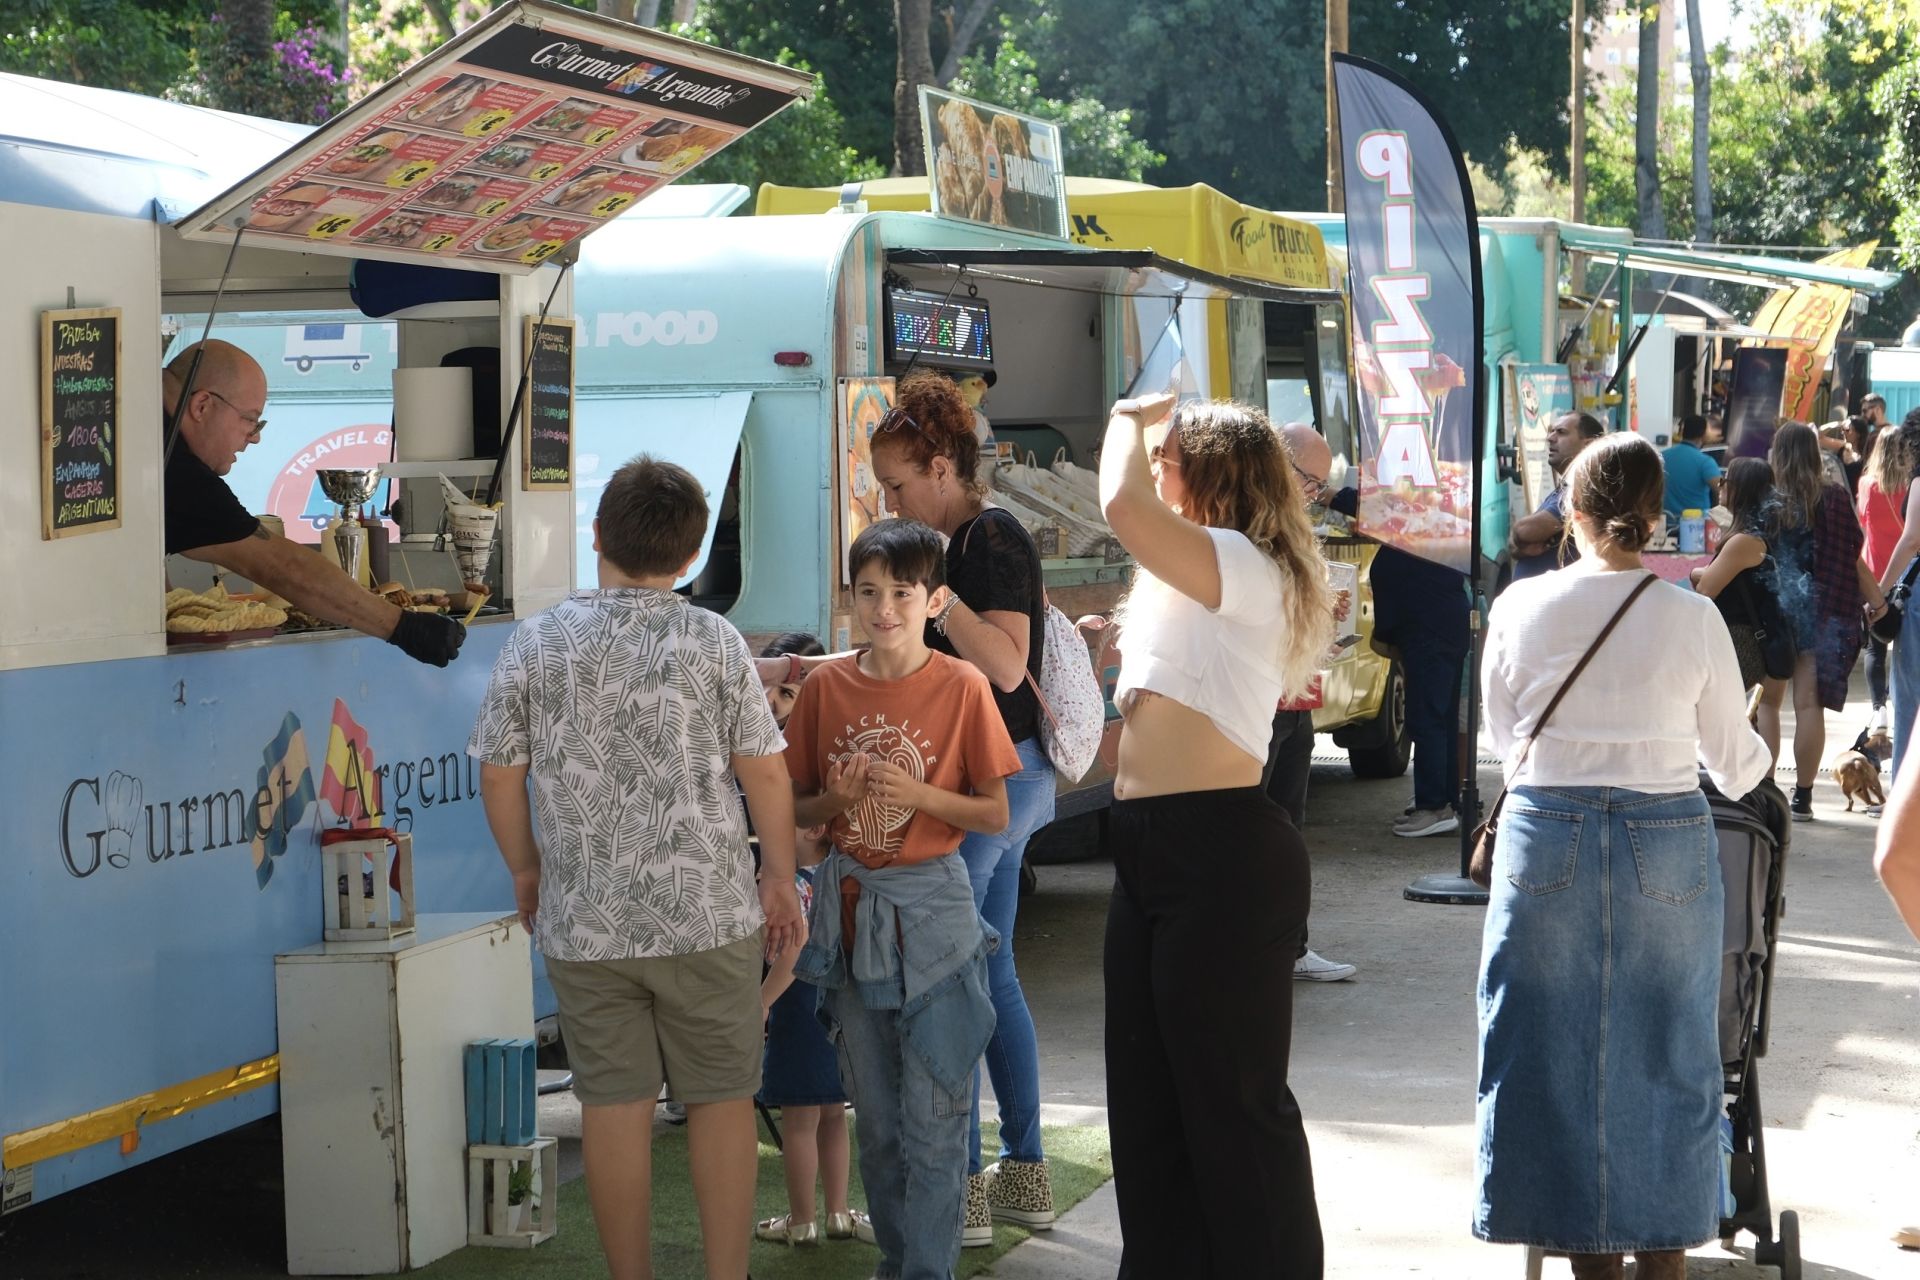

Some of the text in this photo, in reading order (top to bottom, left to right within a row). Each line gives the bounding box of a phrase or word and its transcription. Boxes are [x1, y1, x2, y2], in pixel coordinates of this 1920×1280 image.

[387, 127, 516, 210] BOCADILLOS
[520, 175, 570, 208] PATATAS
[578, 123, 648, 171] EMPANADAS
[316, 217, 352, 234] 6€
[1230, 216, 1315, 255] Food TRUCK
[595, 309, 719, 348] FOOD
[54, 350, 94, 372] NUESTRAS
[285, 430, 390, 476] TRAVEL &
[58, 496, 115, 523] ARGENTINAS
[64, 480, 104, 500] CASERAS
[828, 713, 938, 766] BEACH LIFE
[336, 737, 483, 833] Argent
